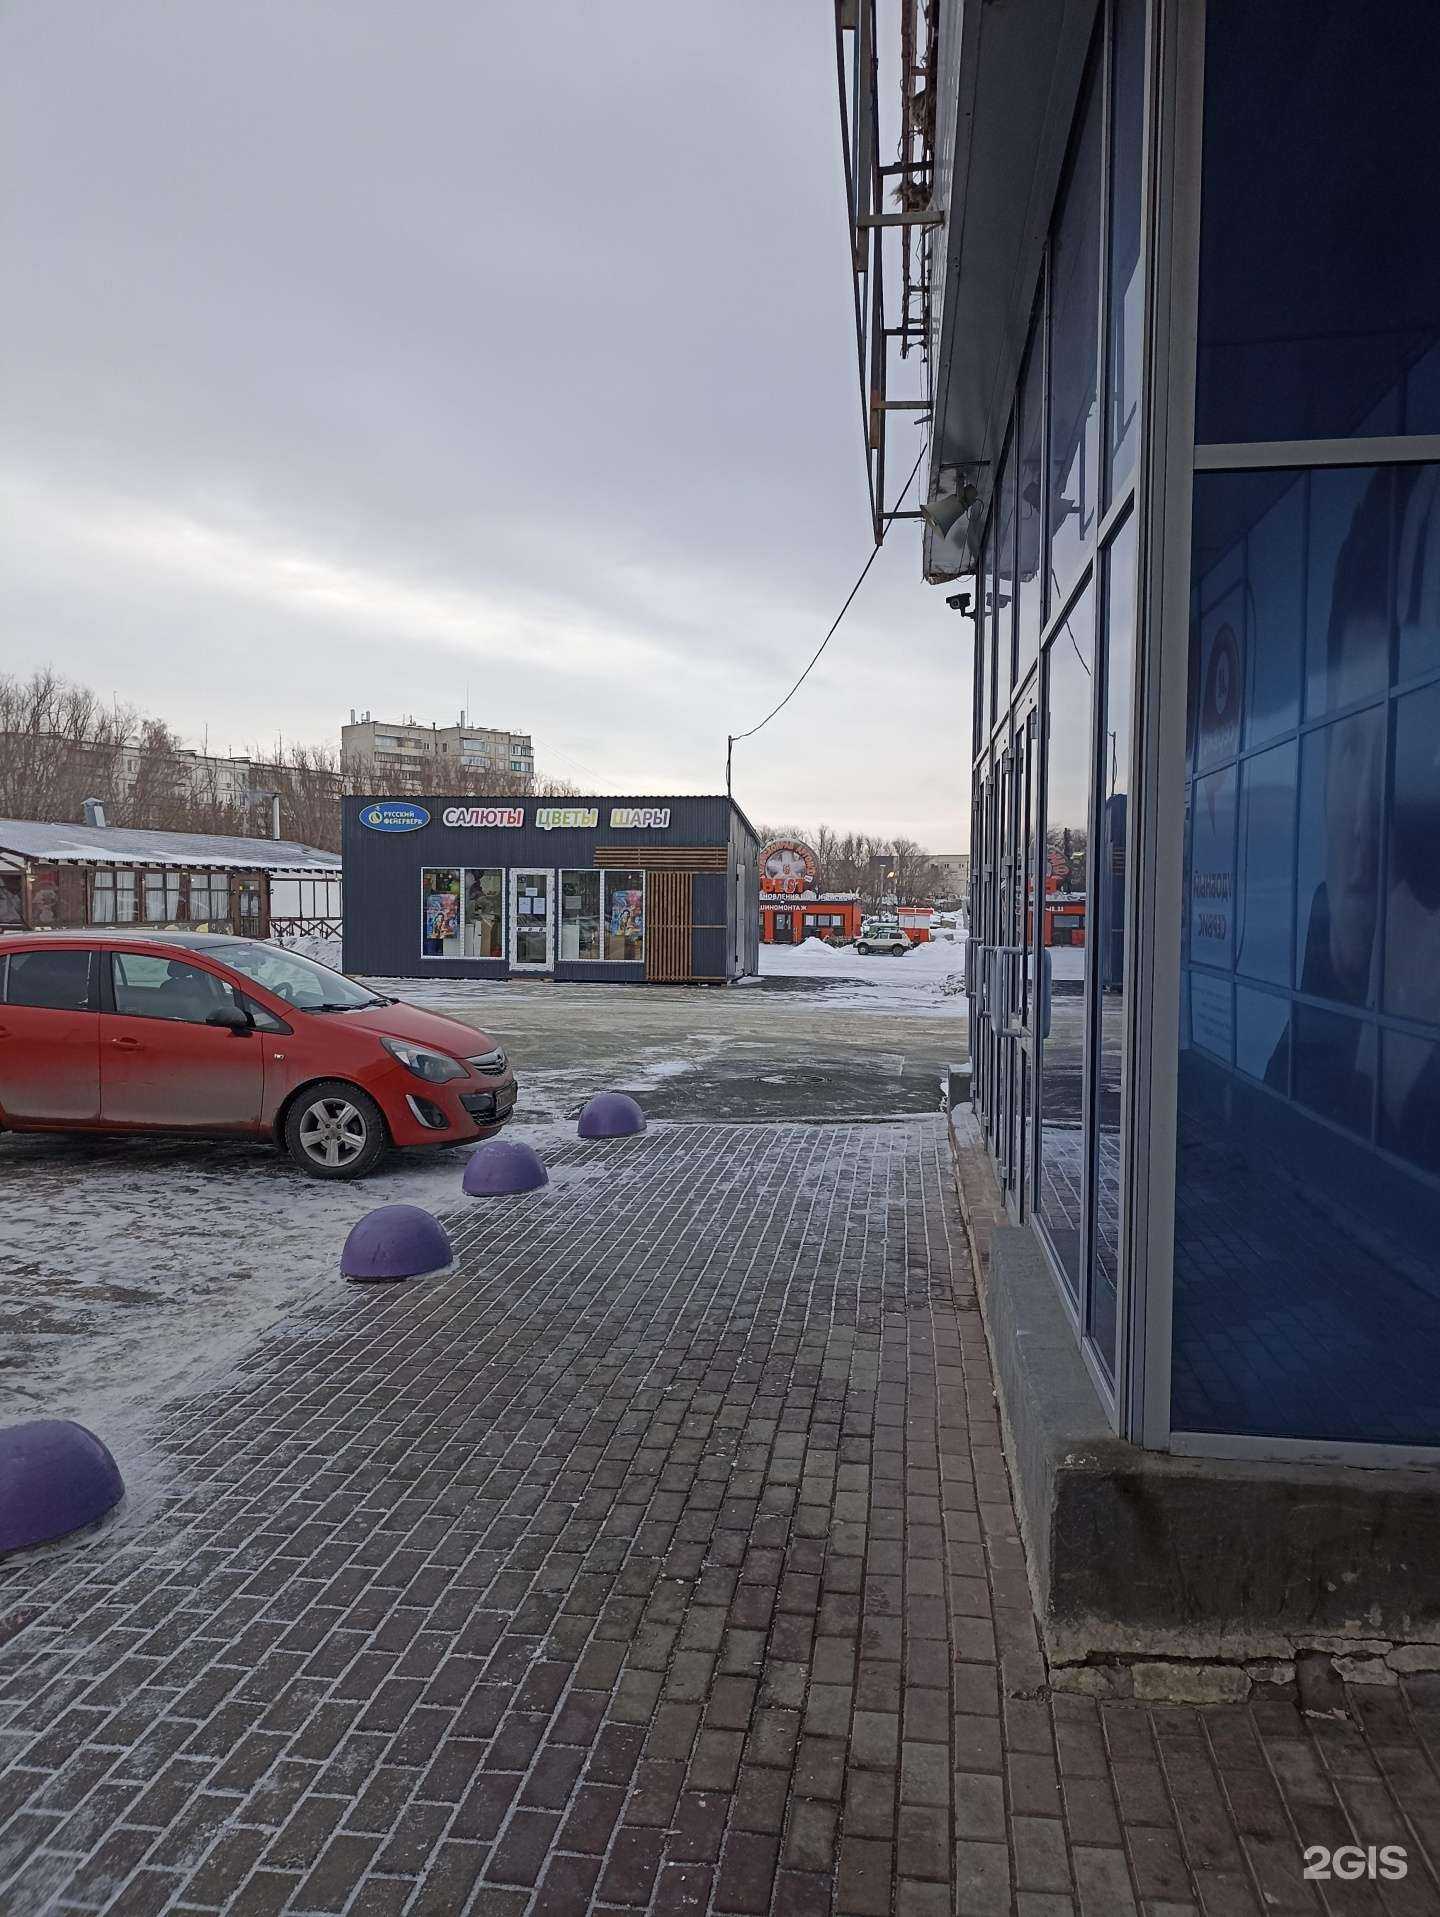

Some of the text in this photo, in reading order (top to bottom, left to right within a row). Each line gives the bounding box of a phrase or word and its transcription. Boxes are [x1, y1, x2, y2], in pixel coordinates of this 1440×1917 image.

[383, 810, 415, 818] РУССКИЙ
[444, 808, 670, 830] САЛЮТЫ ЦВЕТЫ ШАРЫ
